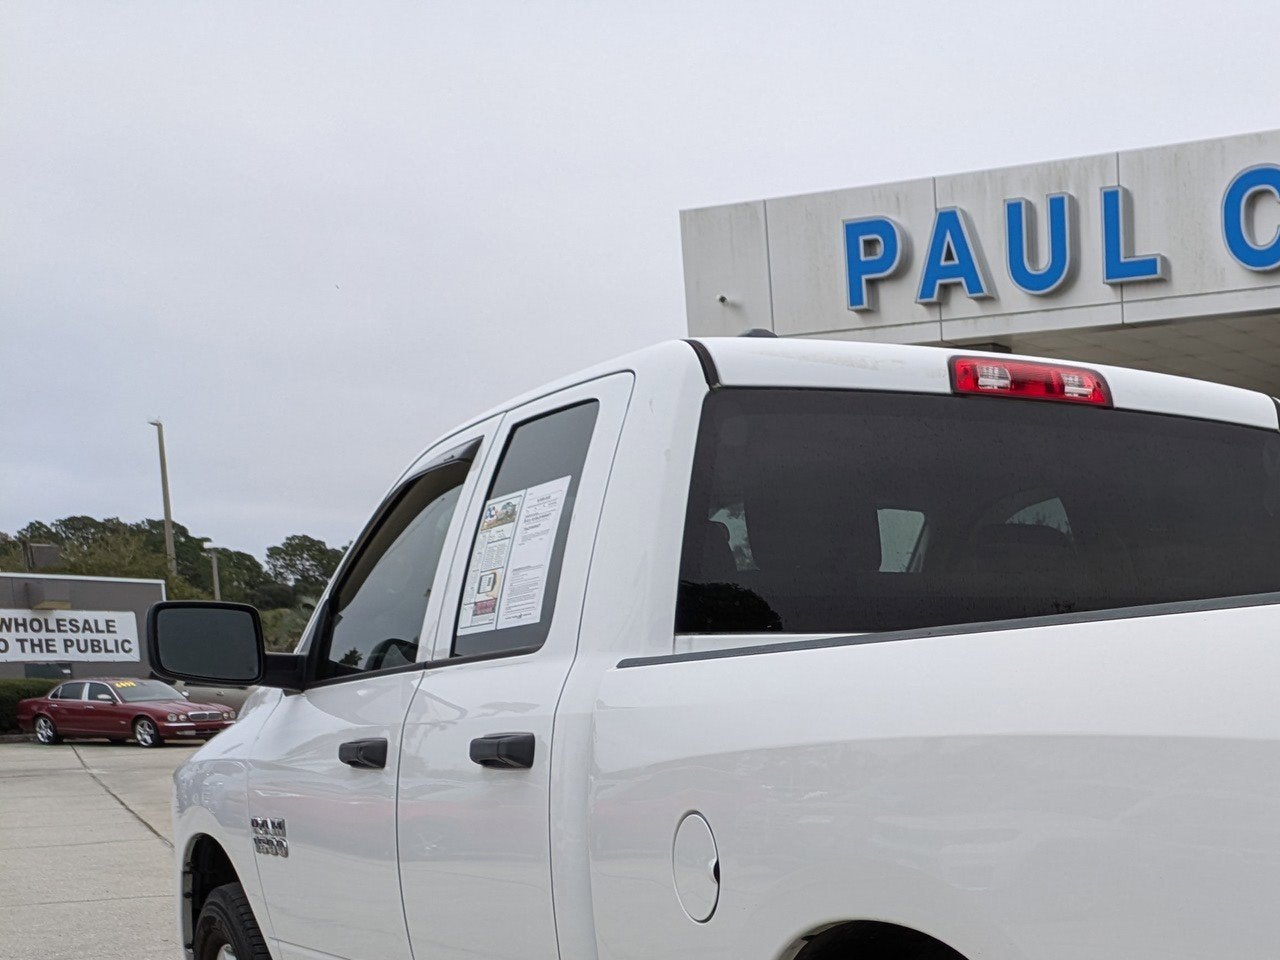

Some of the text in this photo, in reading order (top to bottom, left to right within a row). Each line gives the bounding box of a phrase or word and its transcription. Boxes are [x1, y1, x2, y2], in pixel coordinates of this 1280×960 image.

[841, 185, 1166, 312] PAUL
[0, 617, 117, 634] WHOLESALE
[0, 638, 133, 654] O THE PUBLIC
